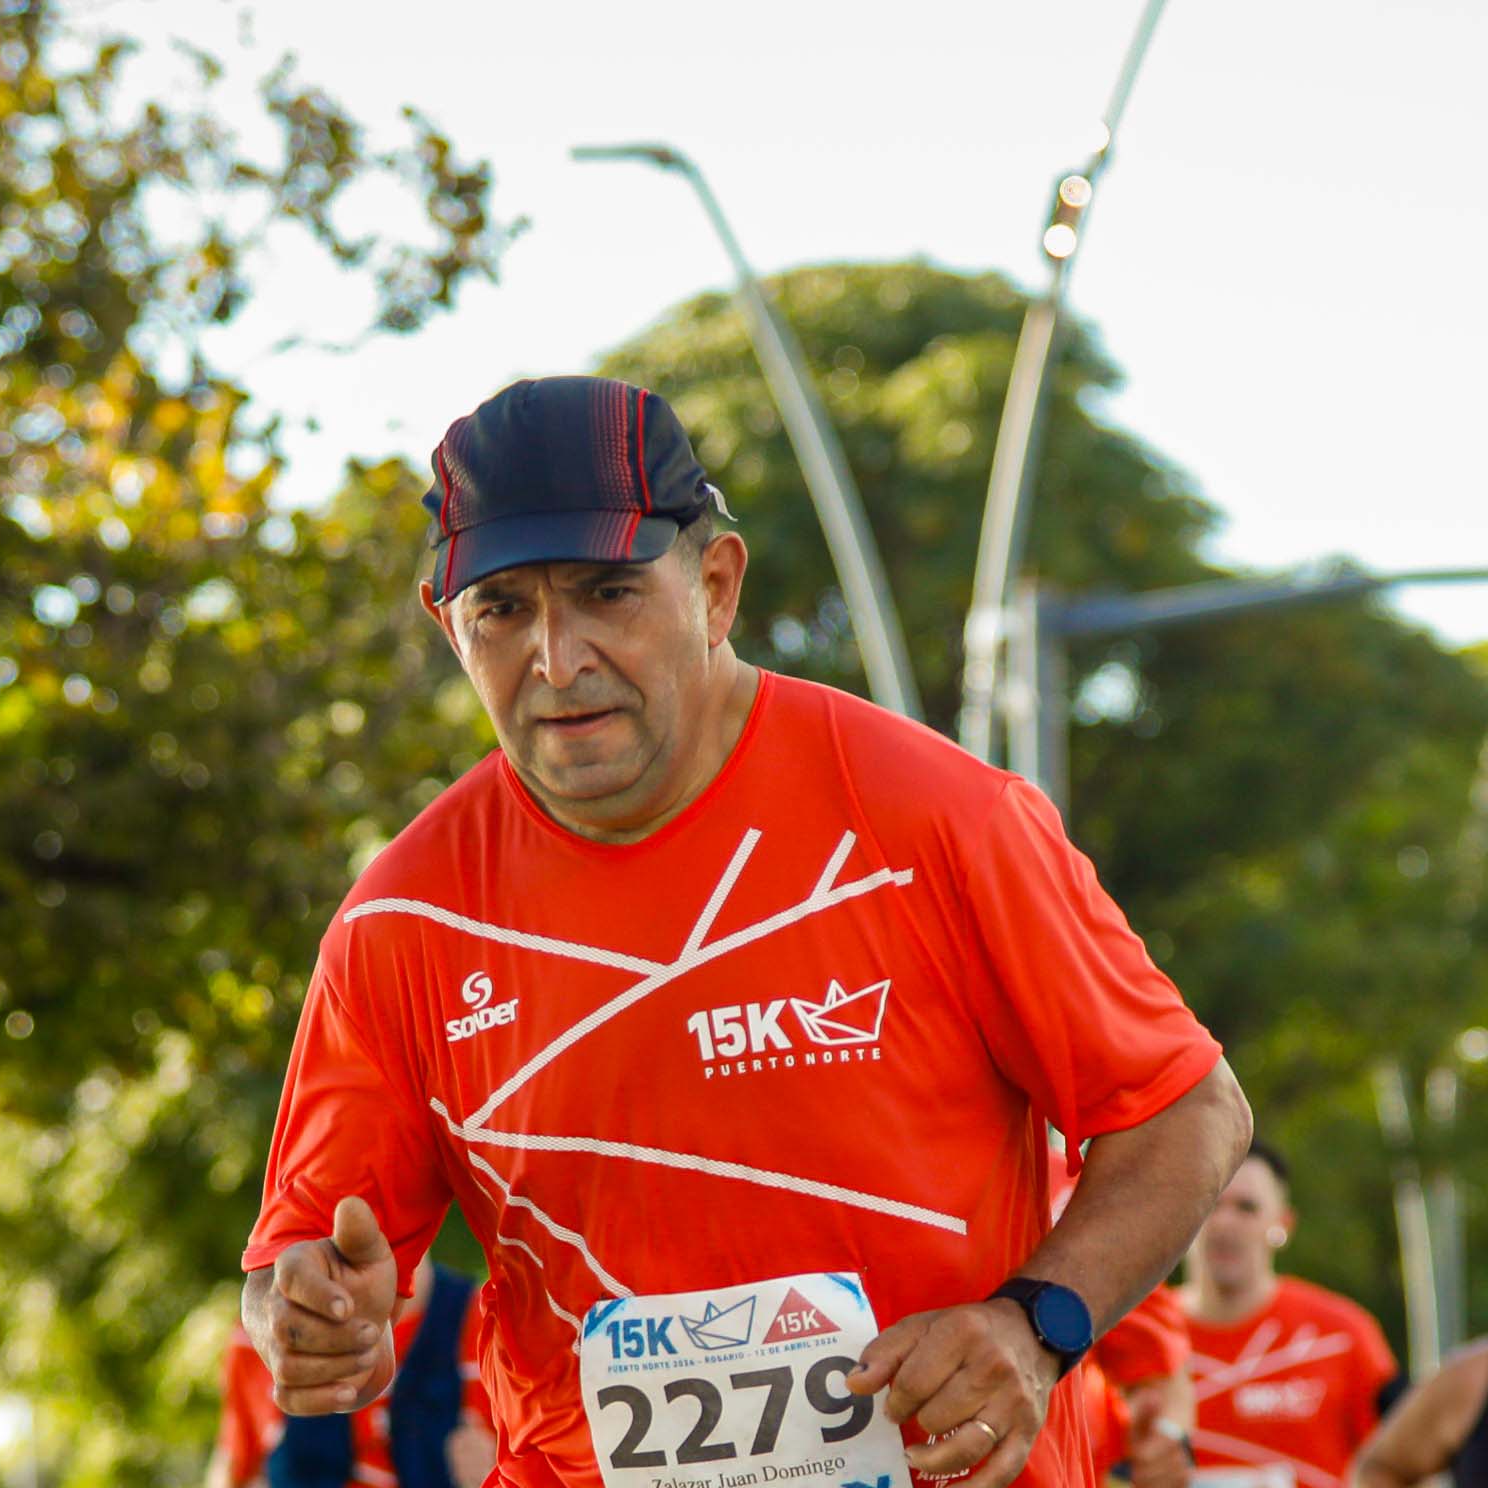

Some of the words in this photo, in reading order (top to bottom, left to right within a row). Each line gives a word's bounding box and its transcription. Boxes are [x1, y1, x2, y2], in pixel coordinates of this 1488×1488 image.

[687, 999, 792, 1061] 15K
[704, 1054, 795, 1079] PUERTO
[805, 1047, 881, 1065] NORTE
[605, 1316, 679, 1359] 15K
[776, 1309, 822, 1335] 15K
[608, 1363, 640, 1374] PUERTO
[642, 1361, 671, 1371] NORTE
[704, 1351, 745, 1363] ROSARIO
[784, 1341, 811, 1352] ABRIL
[596, 1355, 875, 1469] 2279
[761, 1456, 846, 1483] Domingo
